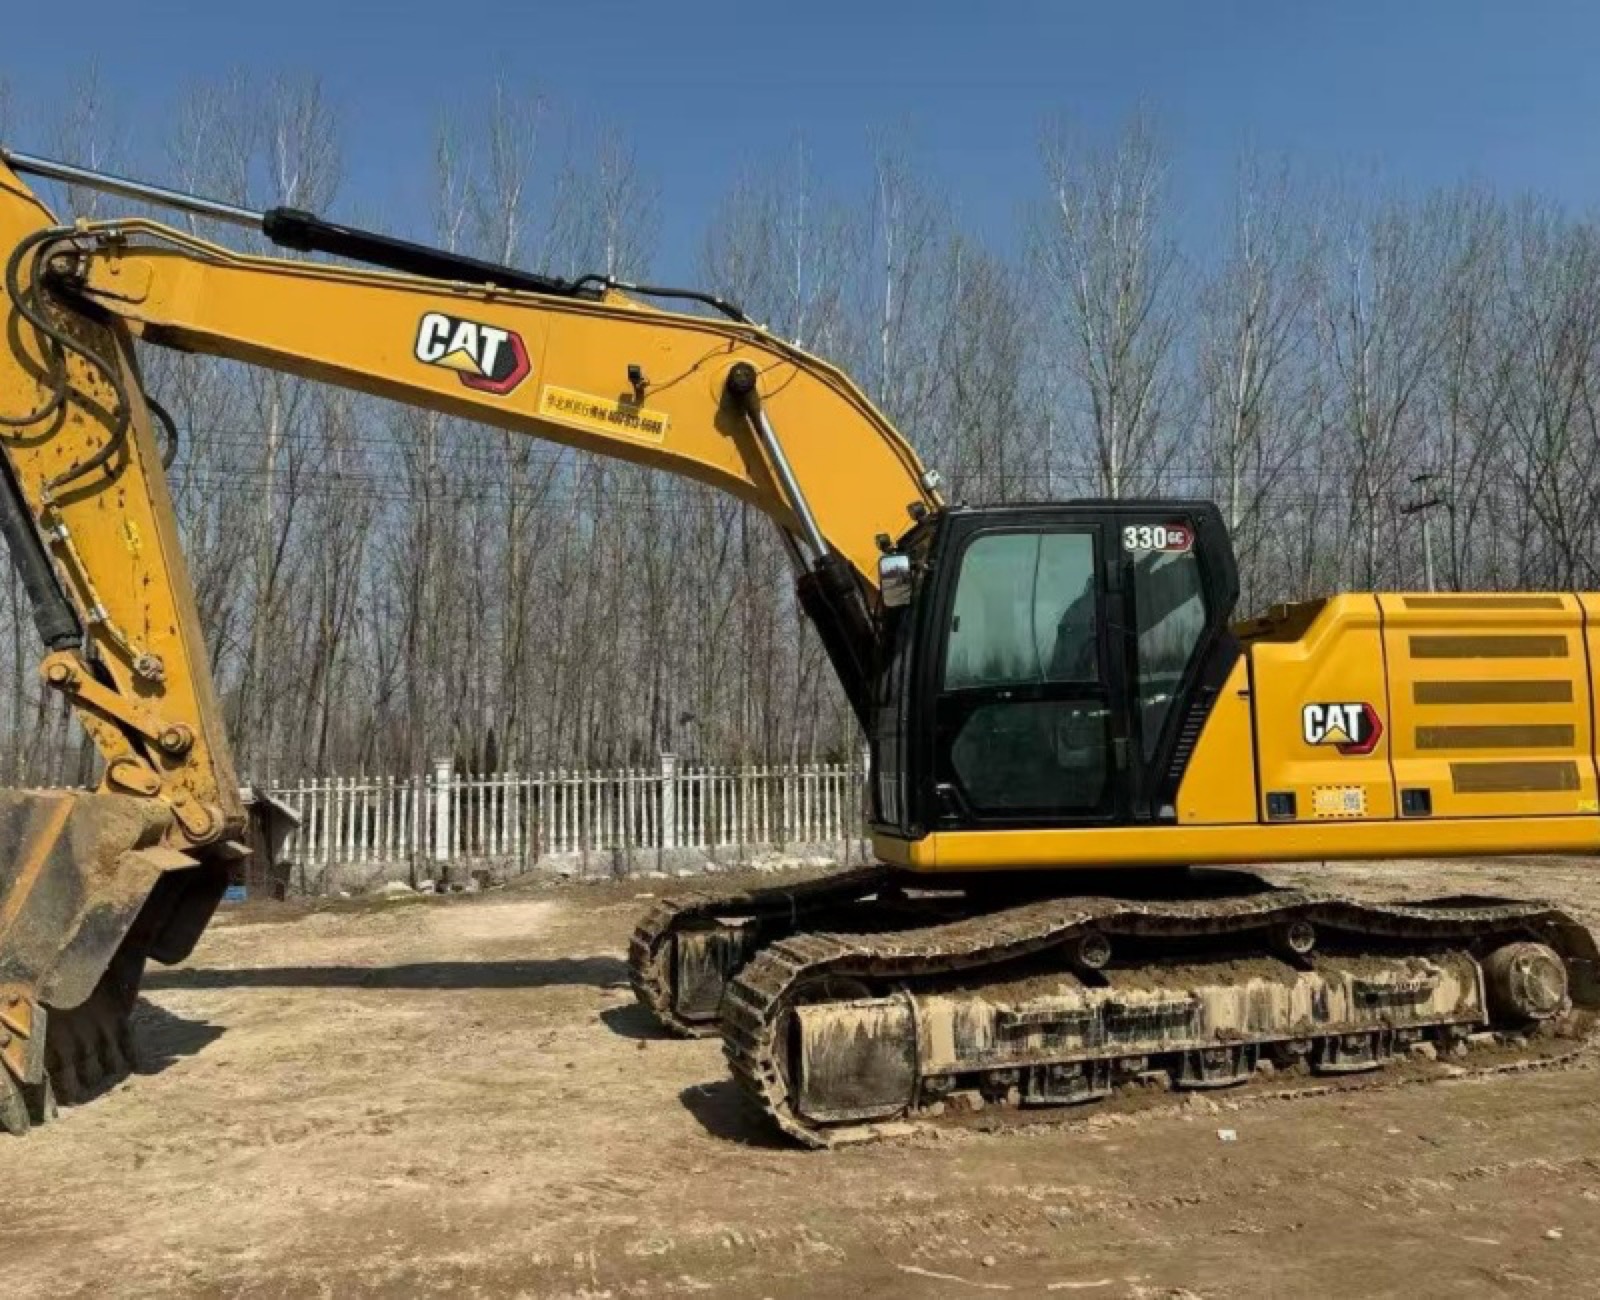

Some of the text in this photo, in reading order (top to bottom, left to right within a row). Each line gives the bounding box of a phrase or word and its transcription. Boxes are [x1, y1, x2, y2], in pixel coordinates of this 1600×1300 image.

[416, 313, 509, 377] CAT
[1124, 526, 1166, 549] 330
[1303, 704, 1363, 743] CAT
